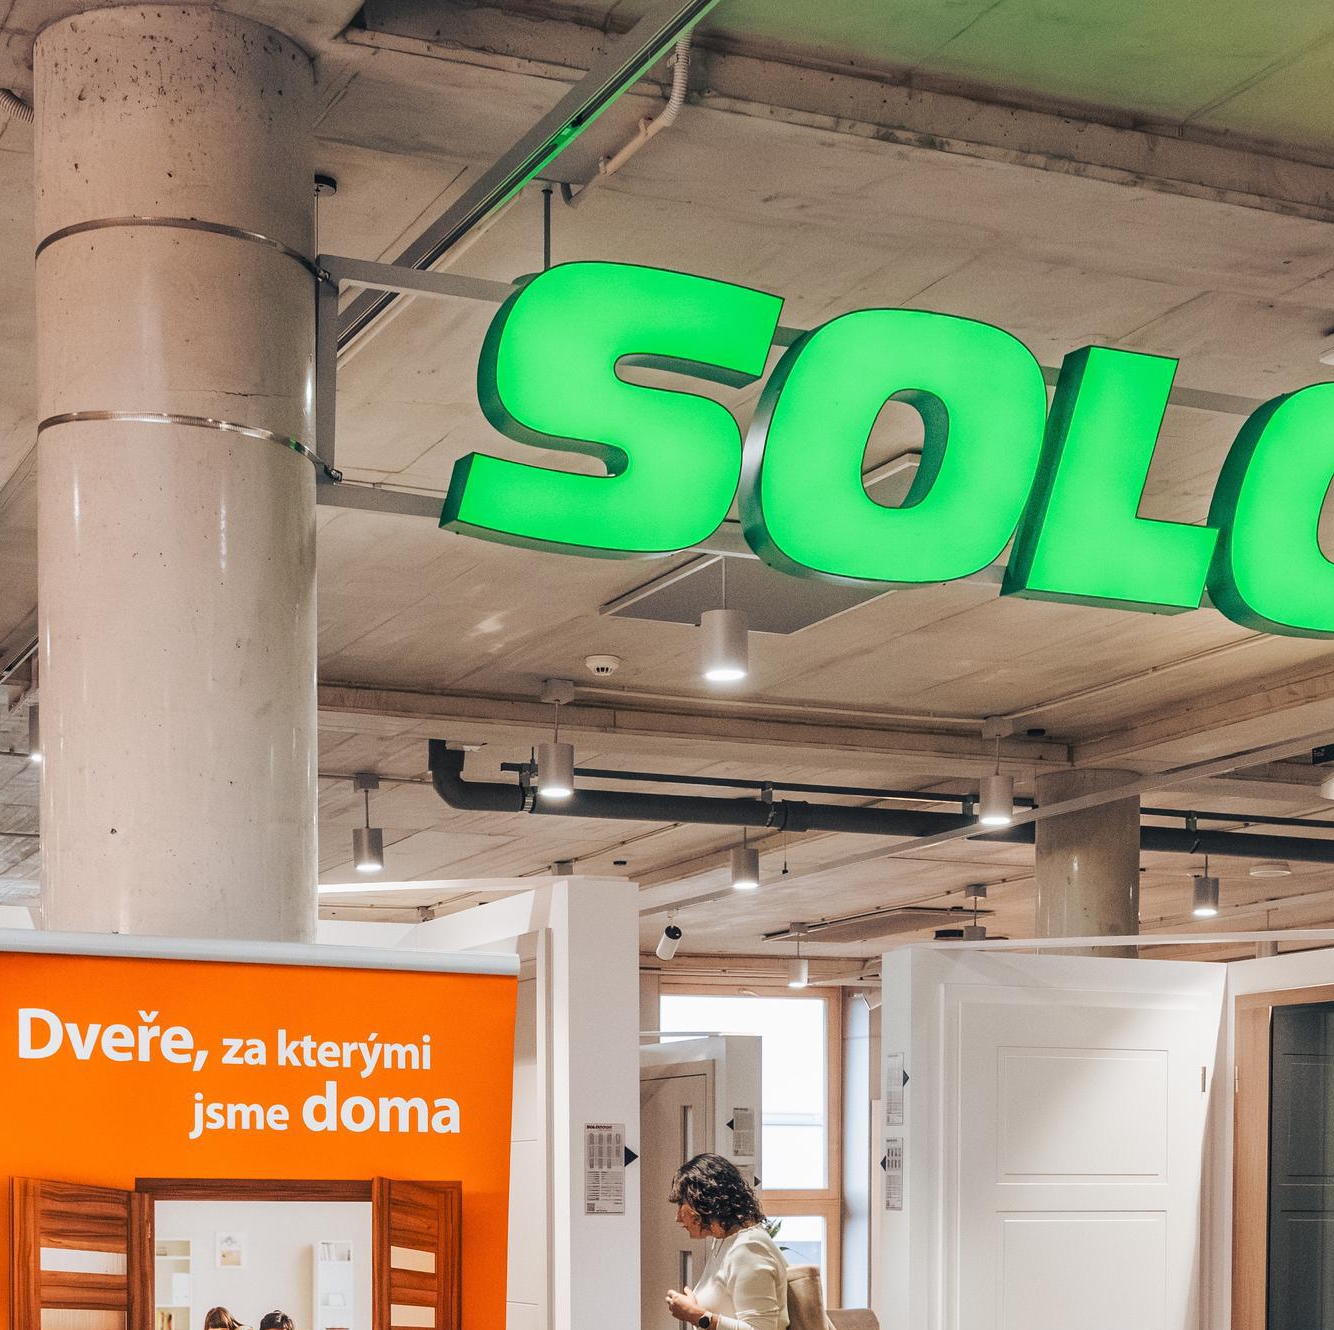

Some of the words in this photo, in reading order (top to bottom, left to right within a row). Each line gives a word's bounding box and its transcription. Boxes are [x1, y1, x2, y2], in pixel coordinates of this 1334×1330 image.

[18, 1007, 209, 1072] Dveře,
[221, 1034, 266, 1066] za
[278, 1029, 432, 1079] kterými
[188, 1093, 290, 1140] jsme
[301, 1081, 462, 1134] doma
